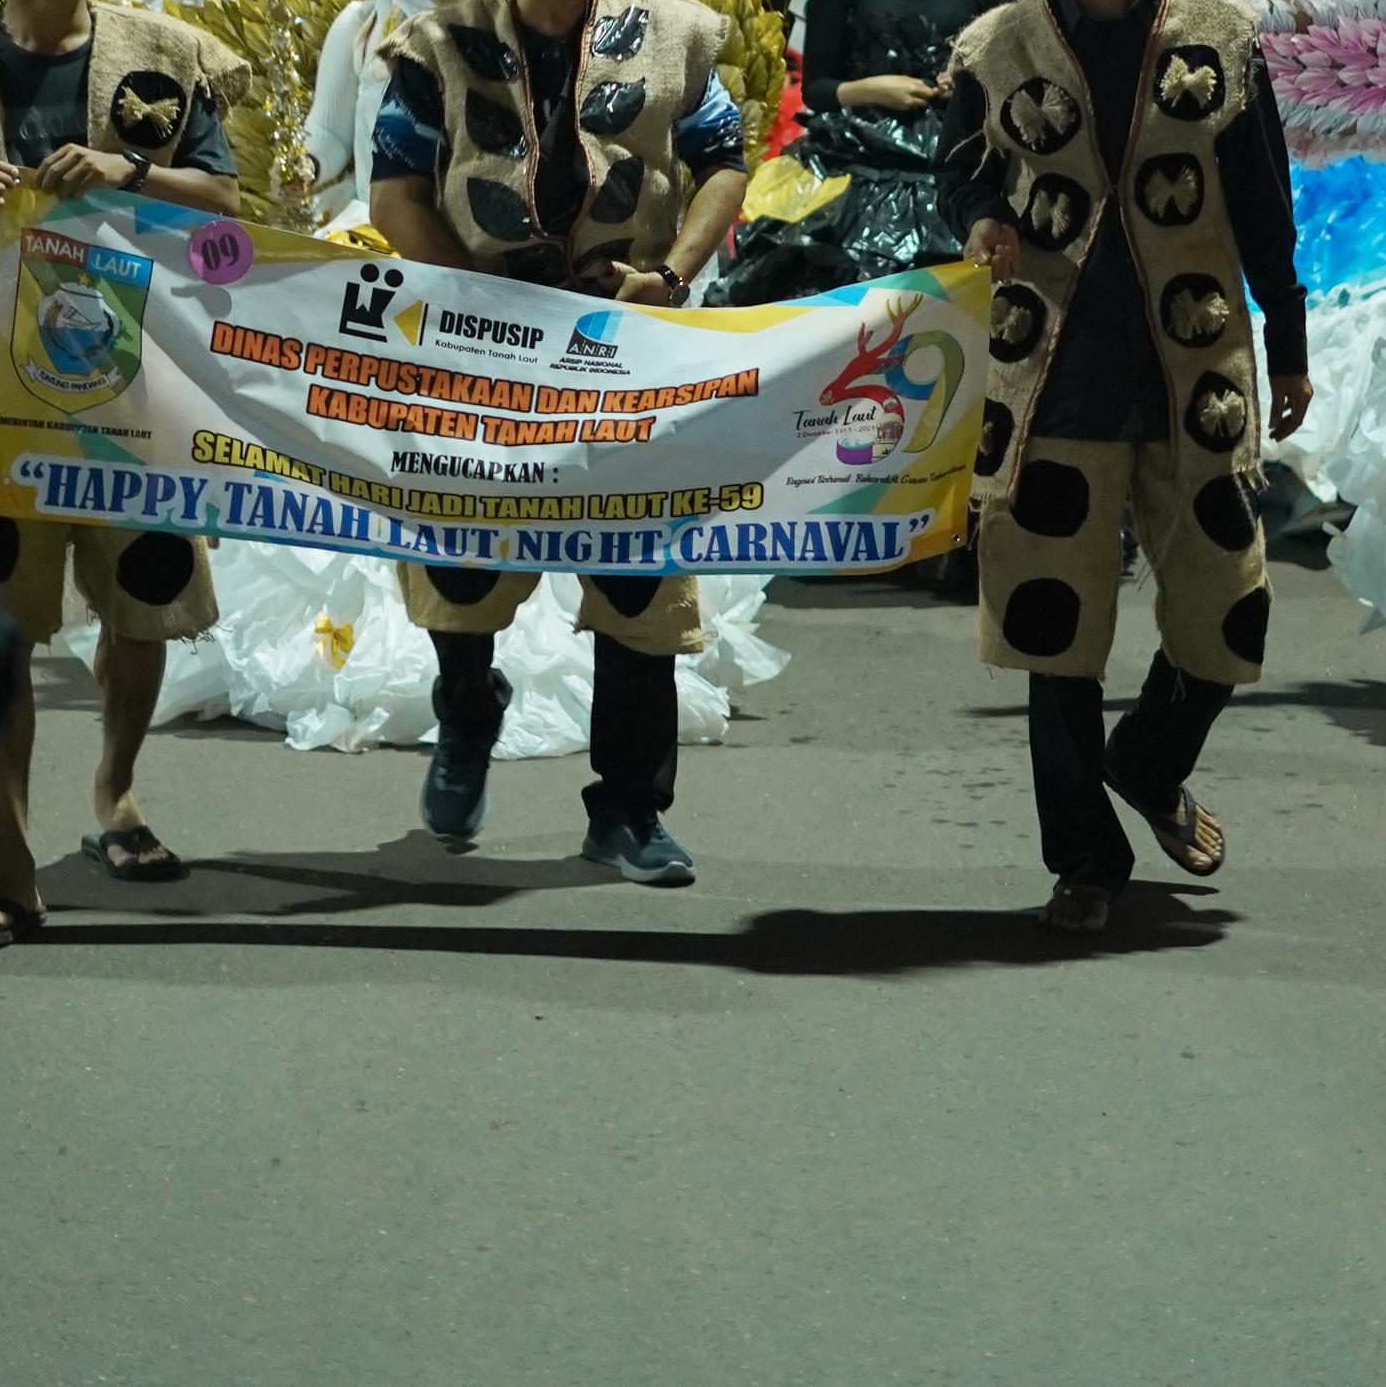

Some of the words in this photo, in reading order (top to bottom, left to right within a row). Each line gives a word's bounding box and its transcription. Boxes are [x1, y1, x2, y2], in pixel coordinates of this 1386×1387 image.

[24, 235, 85, 263] TANAH
[92, 255, 142, 279] LAUT
[201, 233, 240, 271] 09
[439, 310, 544, 350] DISPUSIP
[210, 320, 303, 370] DINAS
[303, 342, 533, 413] PERPUSTAKAAN
[535, 385, 600, 414] DAN
[600, 368, 759, 413] KEARSIPAN
[435, 339, 486, 356] Kabupaten
[488, 349, 516, 361] Tanah
[518, 355, 538, 364] Laut
[584, 360, 623, 369] NASIONAL
[101, 426, 129, 438] TANAH
[130, 429, 153, 440] LAUT
[306, 383, 479, 441] KABUPATEN
[480, 416, 577, 446] TANAH
[578, 416, 656, 443] LAUT
[793, 409, 838, 431] Tanah
[843, 405, 877, 425] Laut
[192, 429, 326, 487] SELAMAT
[328, 471, 403, 510] HARI
[406, 488, 476, 518] JADI
[479, 495, 584, 520] TANAH
[588, 491, 668, 519] LAUT
[671, 481, 765, 518] KE-59
[390, 450, 544, 484] MENGUCAPKAN
[224, 480, 371, 543] TANAH
[387, 516, 500, 561] LAUT
[515, 528, 664, 565] NIGHT
